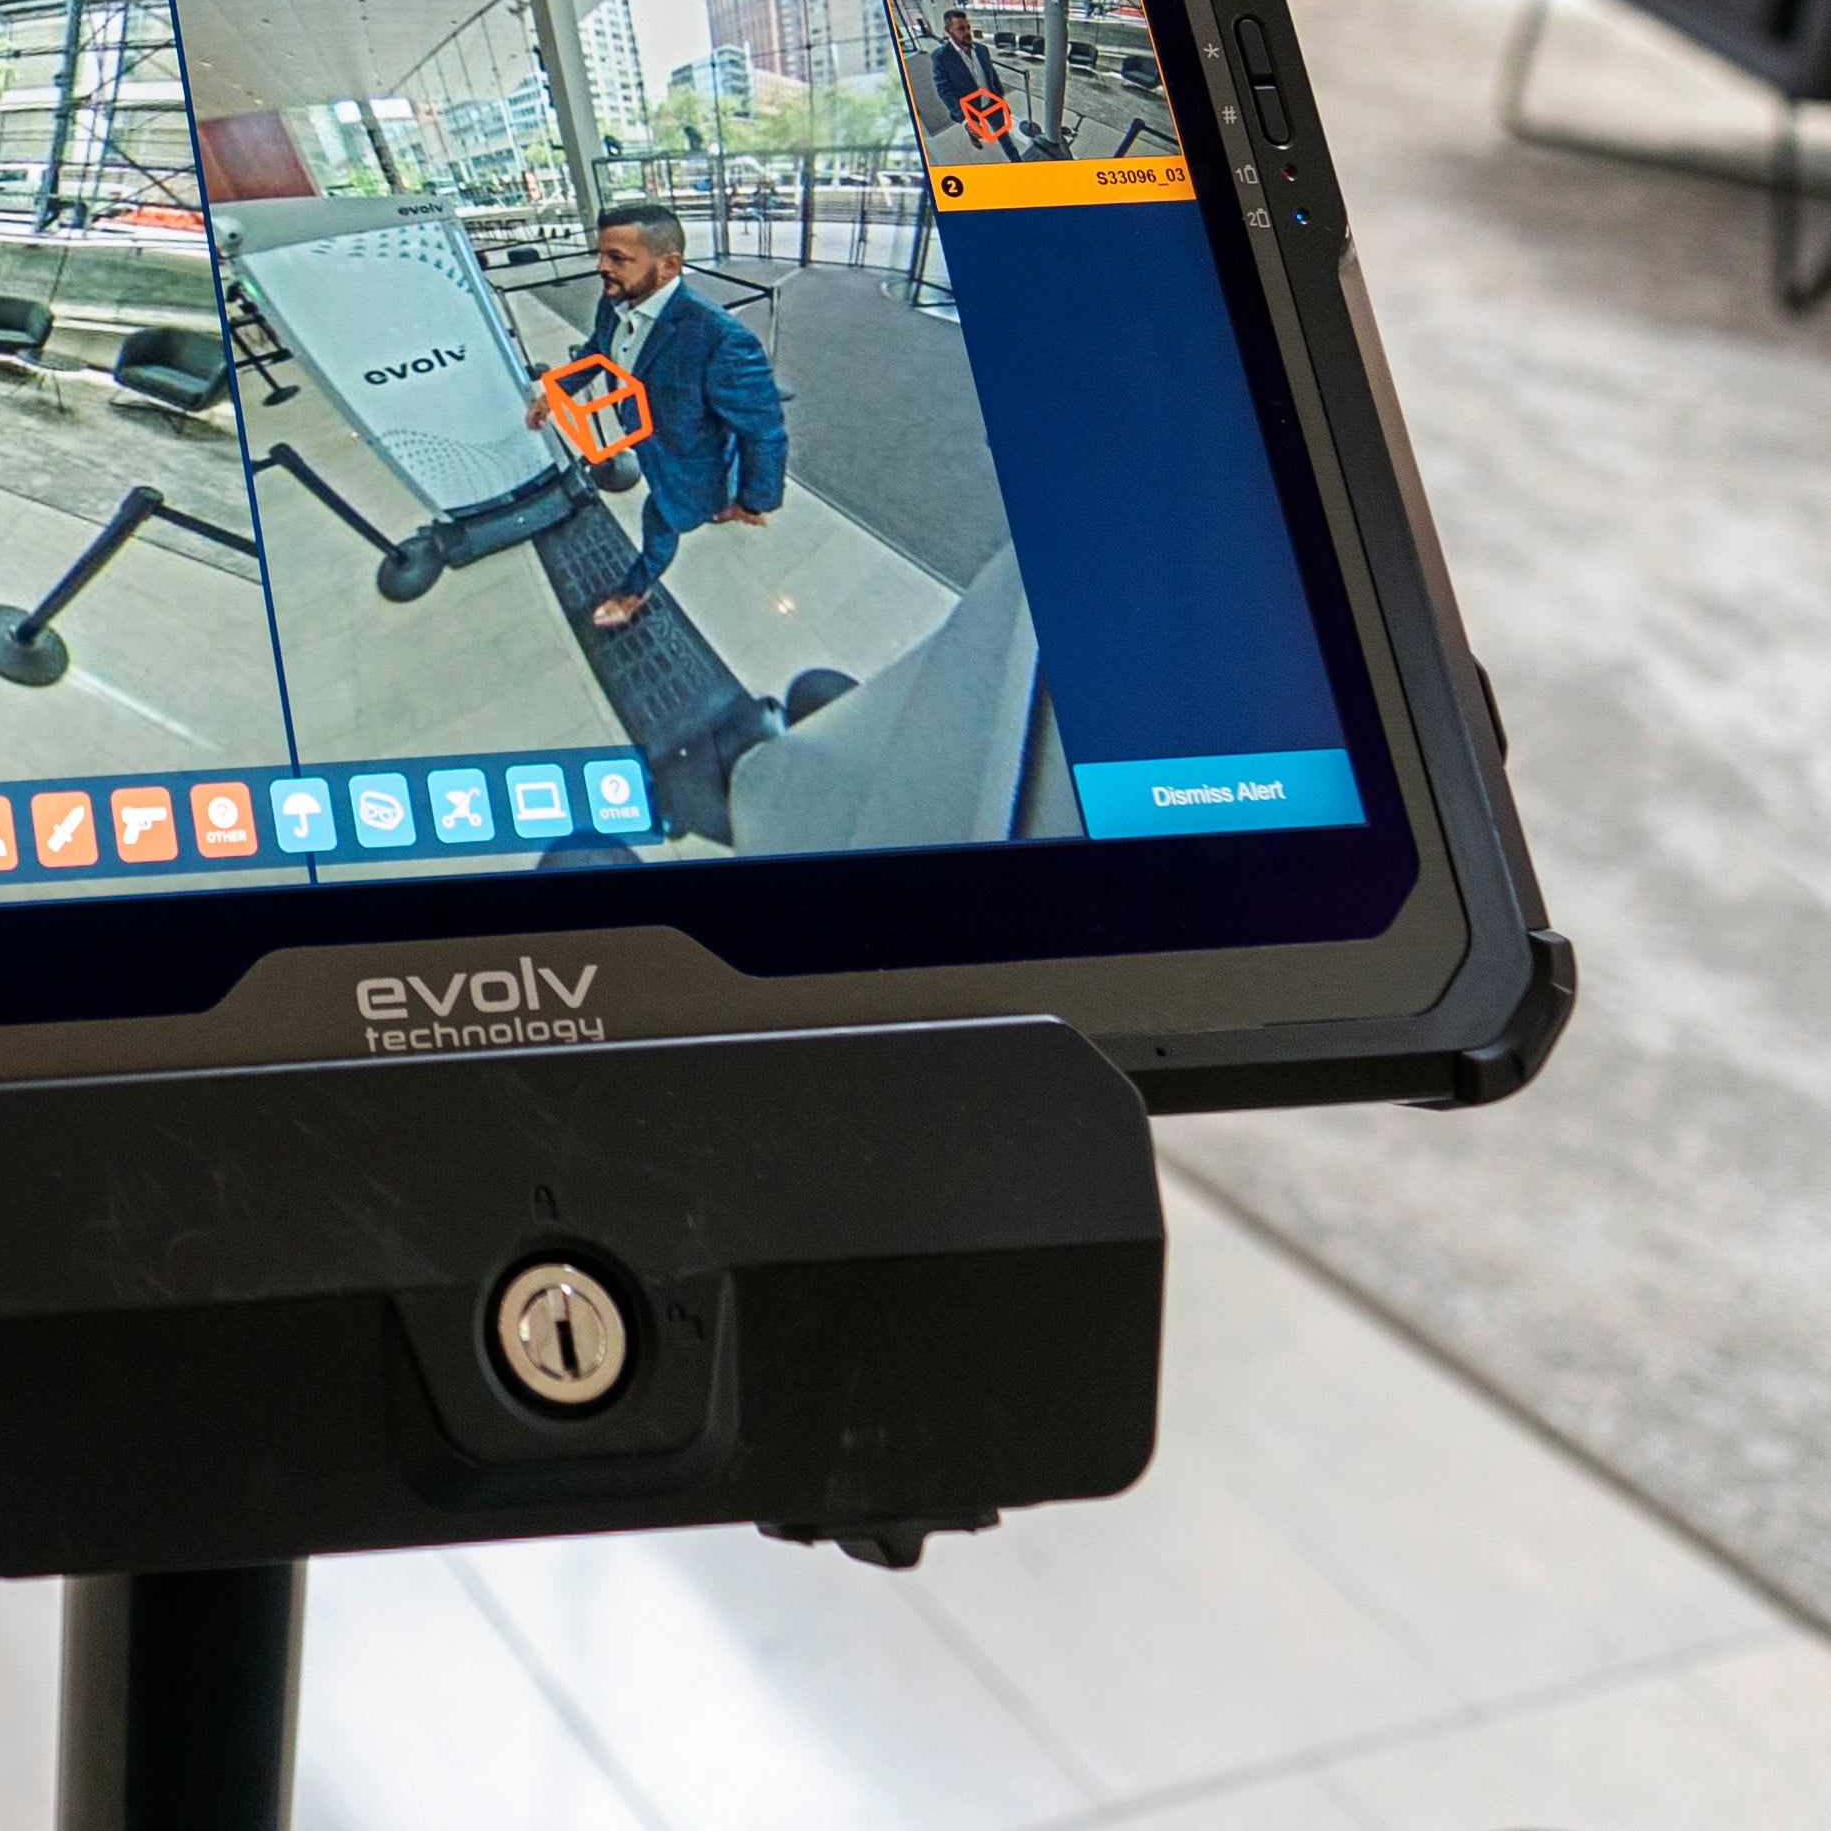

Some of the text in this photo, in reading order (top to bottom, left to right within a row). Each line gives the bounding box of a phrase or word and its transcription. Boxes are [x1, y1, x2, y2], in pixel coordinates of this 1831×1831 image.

[1096, 168, 1186, 186] S33096_03
[398, 203, 444, 216] evolv
[1248, 212, 1260, 227] 2
[363, 344, 466, 385] evolv
[1151, 780, 1286, 807] Dismiss Alert
[599, 806, 640, 820] OTHER
[206, 829, 247, 844] OTHER
[356, 956, 598, 1020] evolv
[365, 1017, 605, 1053] technology
